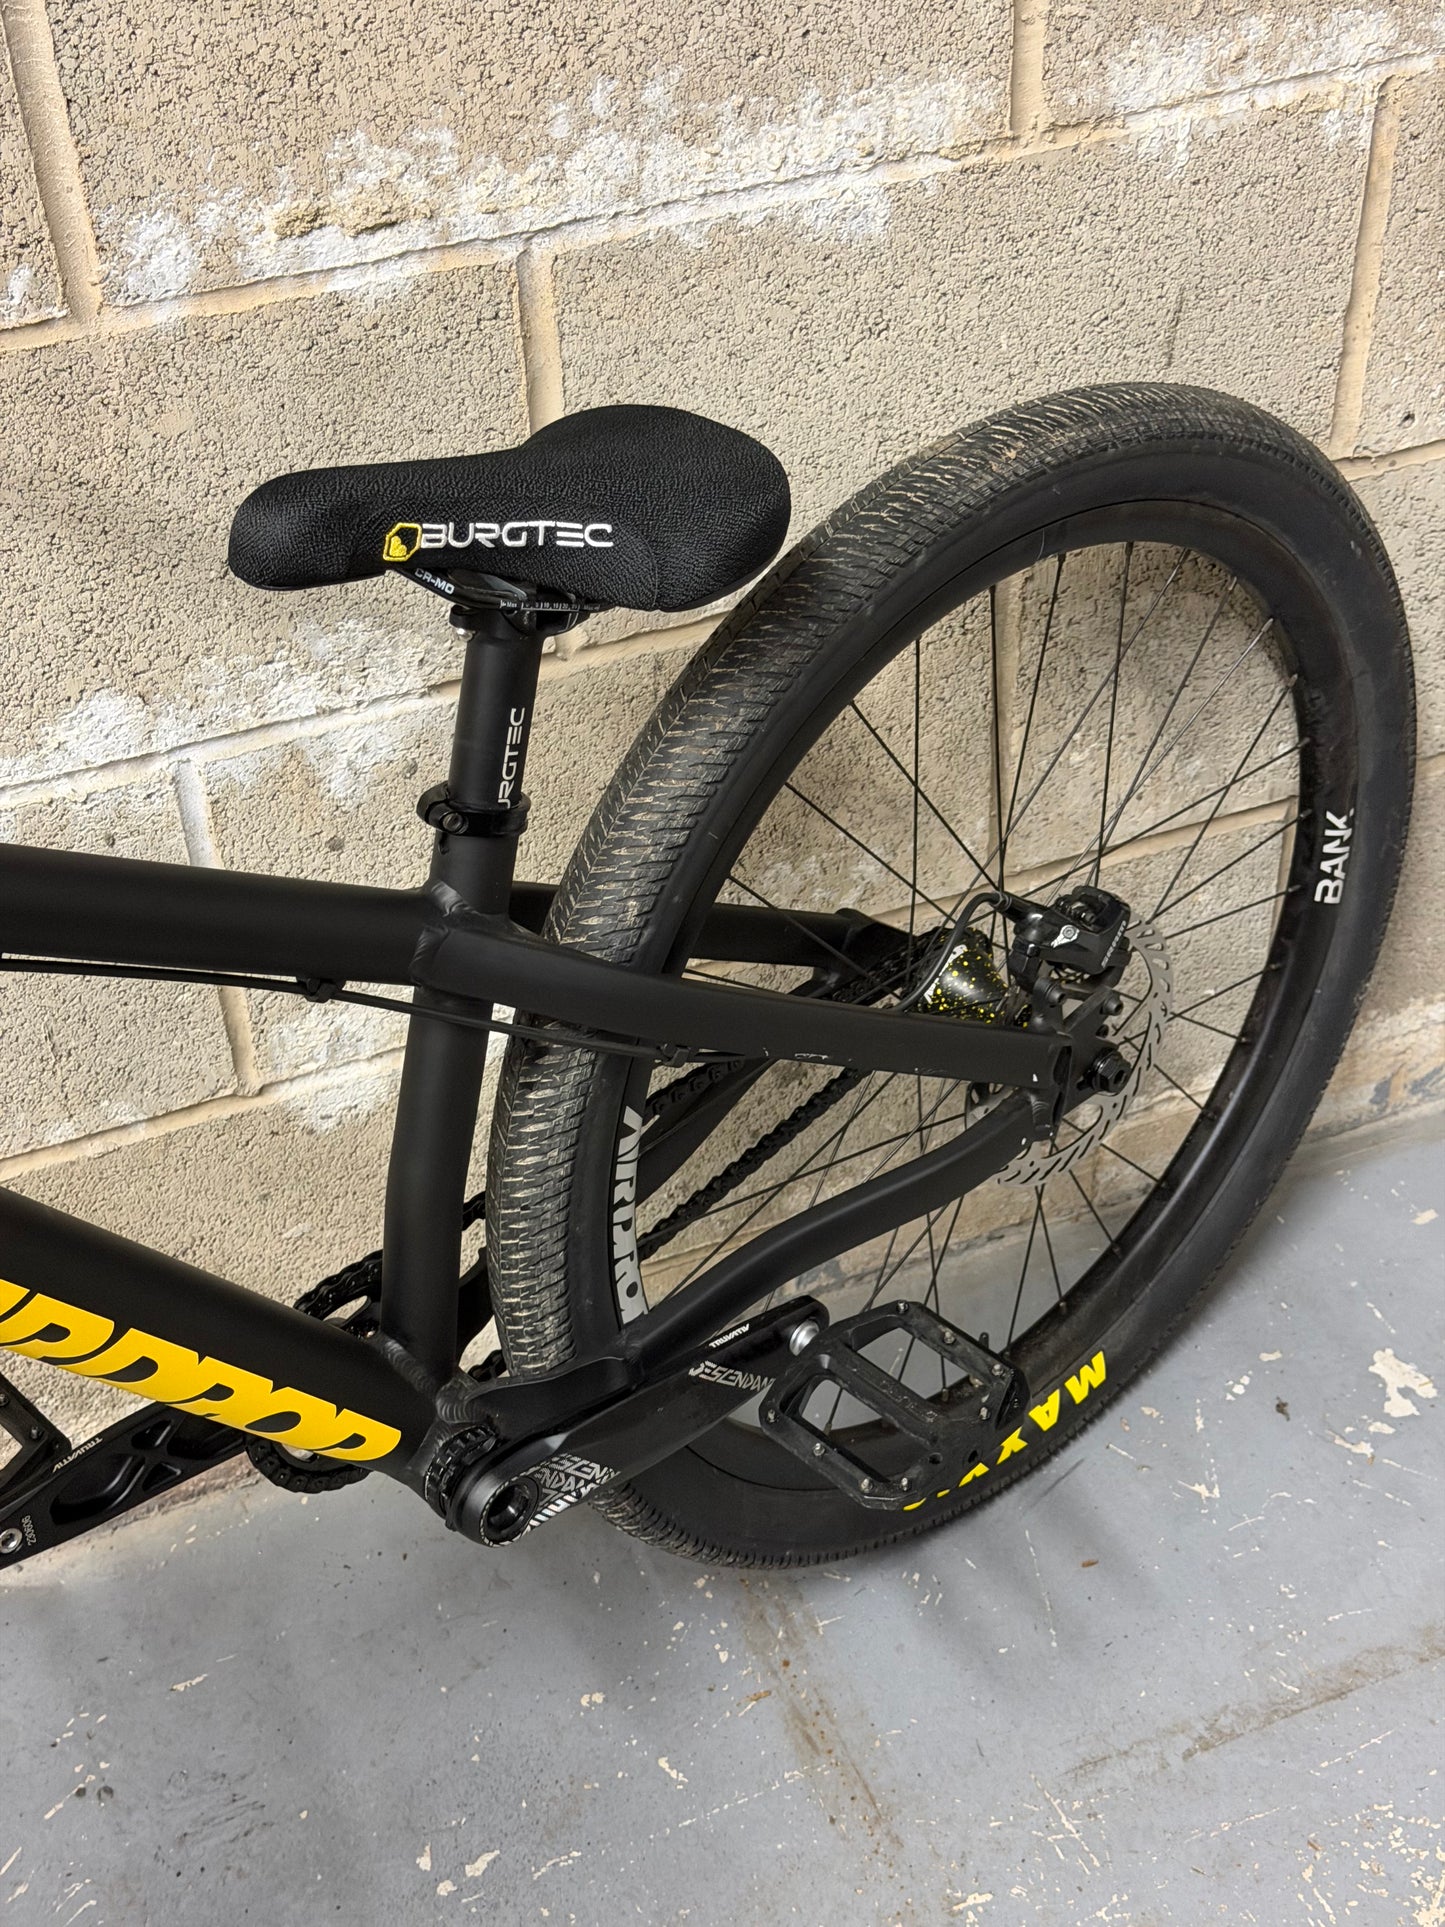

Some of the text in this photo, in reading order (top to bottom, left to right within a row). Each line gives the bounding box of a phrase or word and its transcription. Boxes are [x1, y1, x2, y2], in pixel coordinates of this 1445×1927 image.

[420, 520, 614, 549] BURGTEC
[414, 567, 455, 595] CR-MO
[708, 1322, 750, 1348] TRUVATIV
[52, 1437, 103, 1473] TRUVATIV
